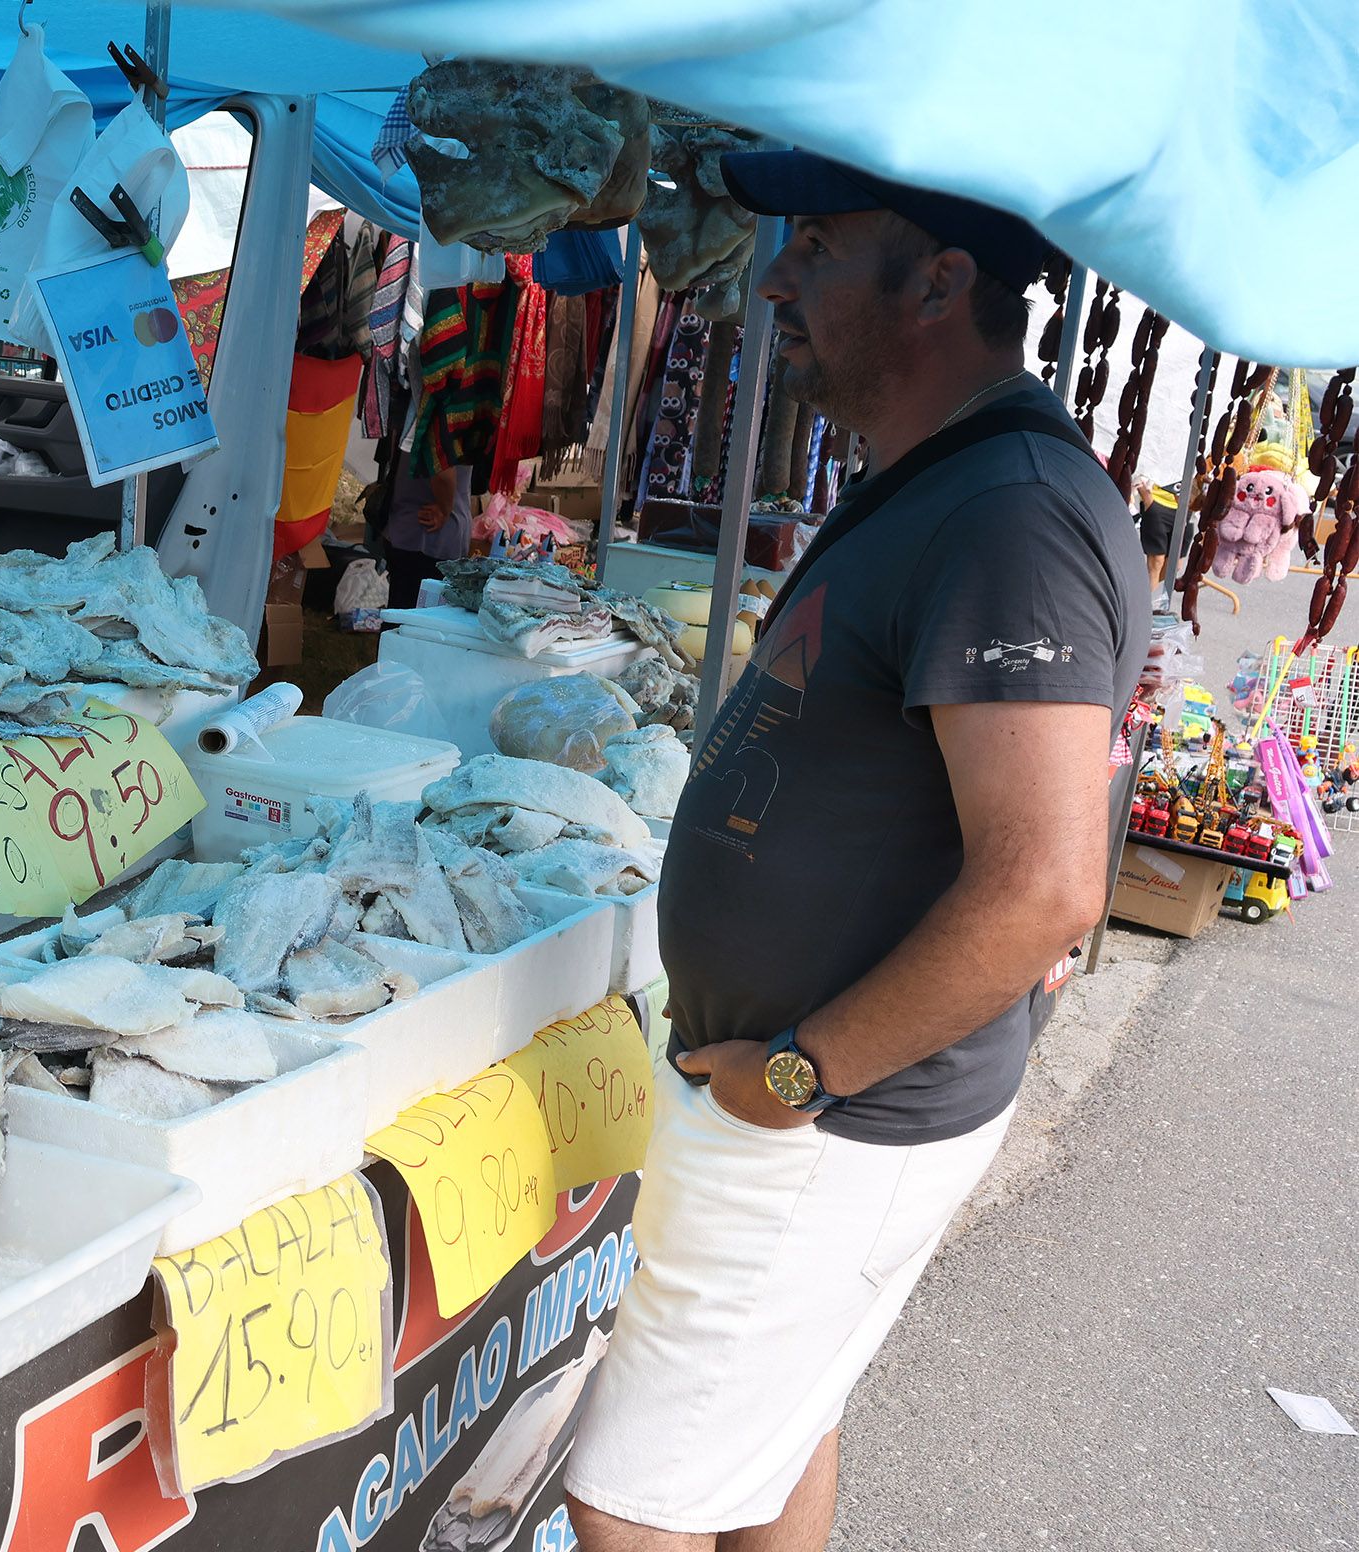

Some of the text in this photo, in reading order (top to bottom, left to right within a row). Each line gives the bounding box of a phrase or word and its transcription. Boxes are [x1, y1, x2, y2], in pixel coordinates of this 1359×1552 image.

[17, 164, 37, 229] RECICLADO
[128, 295, 168, 313] mastercard
[68, 325, 118, 352] VISA
[105, 375, 185, 411] CRÉDITO
[152, 399, 208, 430] AMOS
[225, 787, 281, 808] Gastronorm
